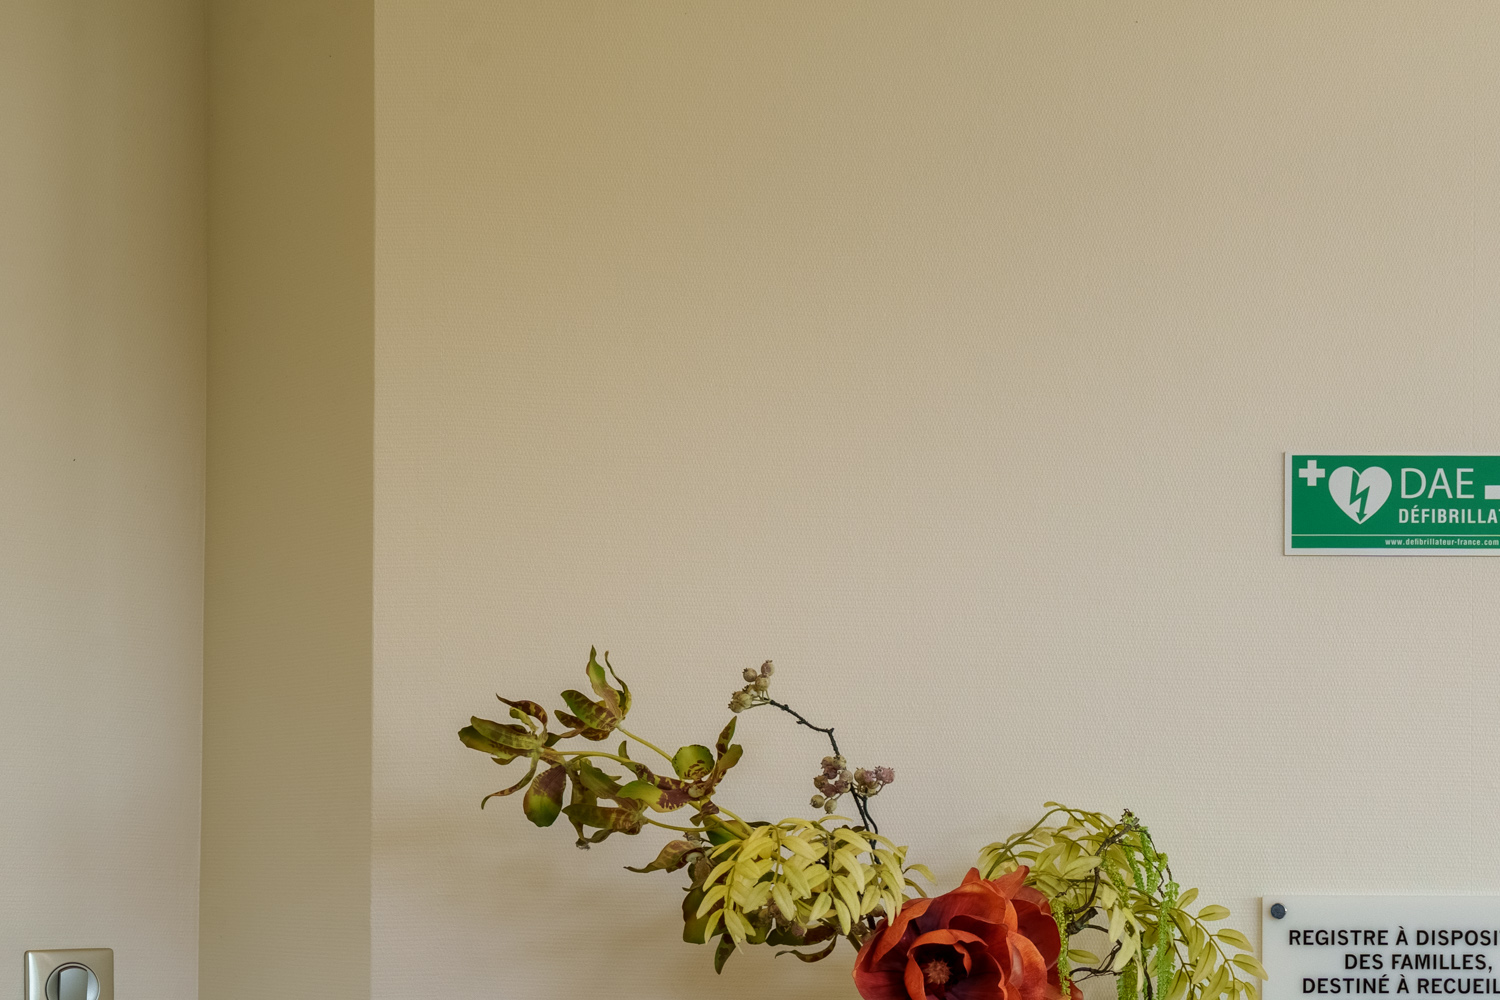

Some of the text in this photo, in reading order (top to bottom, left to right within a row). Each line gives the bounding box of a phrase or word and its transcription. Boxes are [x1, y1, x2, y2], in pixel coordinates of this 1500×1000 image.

[1401, 467, 1475, 499] DAE
[1385, 538, 1500, 546] www.defibrillateur-france.com
[1288, 930, 1389, 946] REGISTRE
[1395, 926, 1409, 946] À
[1344, 954, 1493, 973] DES FAMILLES,
[1302, 974, 1390, 994] DESTINÉ
[1396, 974, 1410, 994] À
